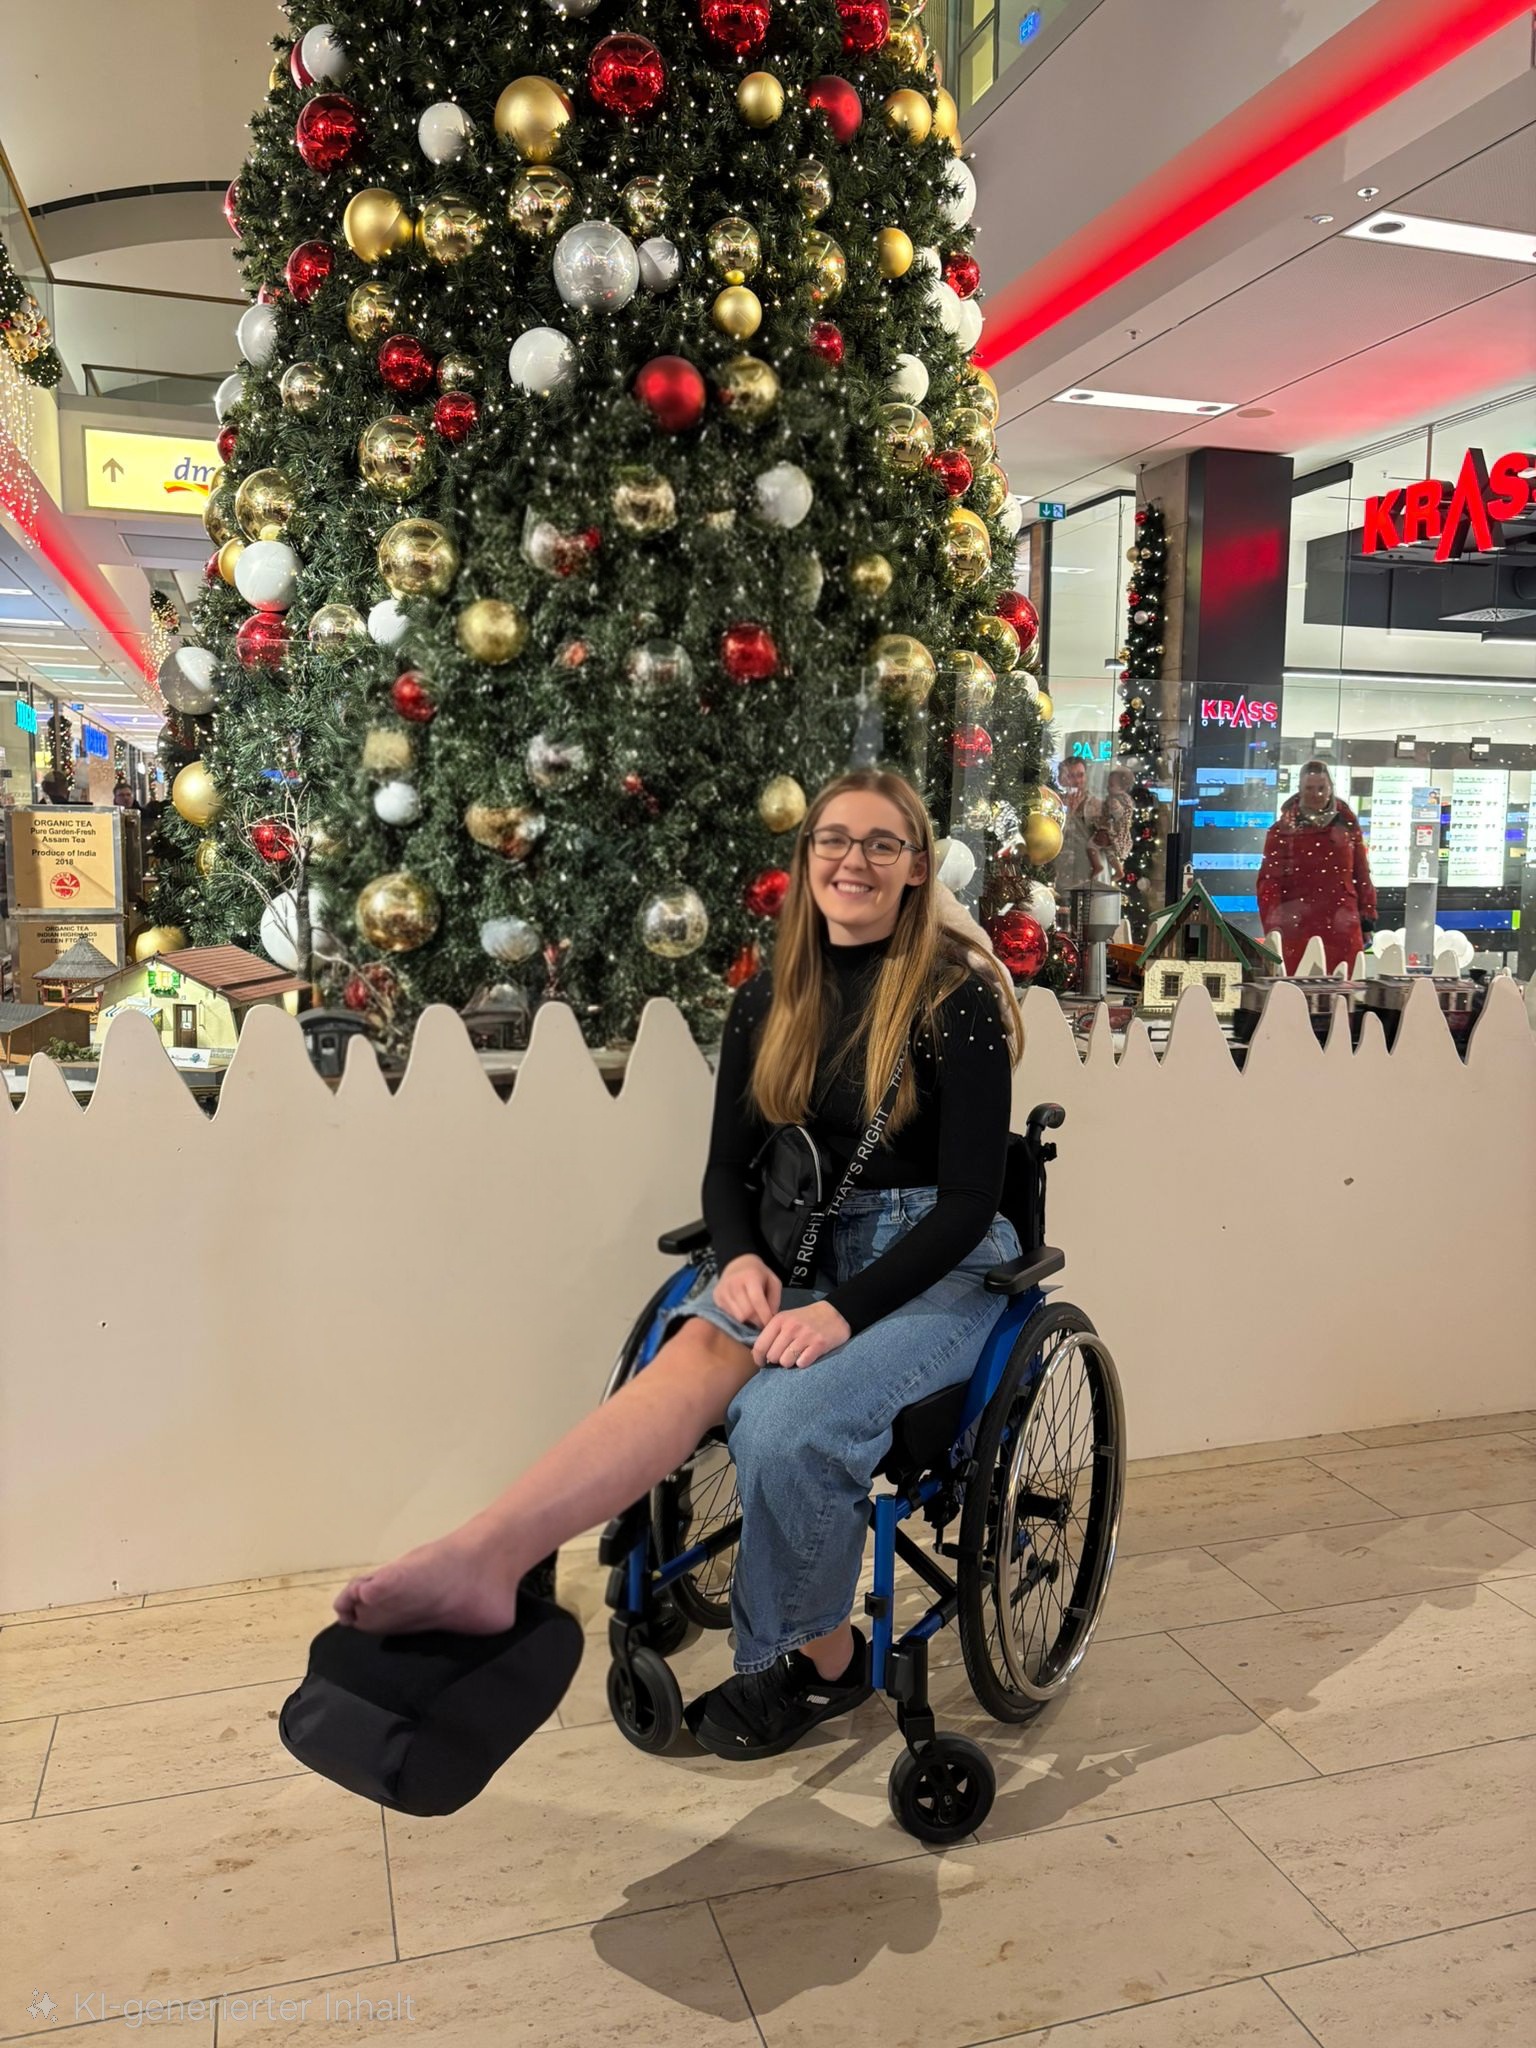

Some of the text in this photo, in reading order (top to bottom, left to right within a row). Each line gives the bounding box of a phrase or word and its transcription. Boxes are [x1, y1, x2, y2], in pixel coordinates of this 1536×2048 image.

[1362, 448, 1536, 563] KRAS
[1201, 695, 1278, 728] KRASS
[1201, 719, 1277, 728] OPTIK
[33, 819, 74, 827] ORGANIC
[30, 827, 47, 835] Pure
[31, 849, 65, 857] Produce
[827, 1162, 863, 1216] THAT'S
[857, 1106, 889, 1161] RIGHT
